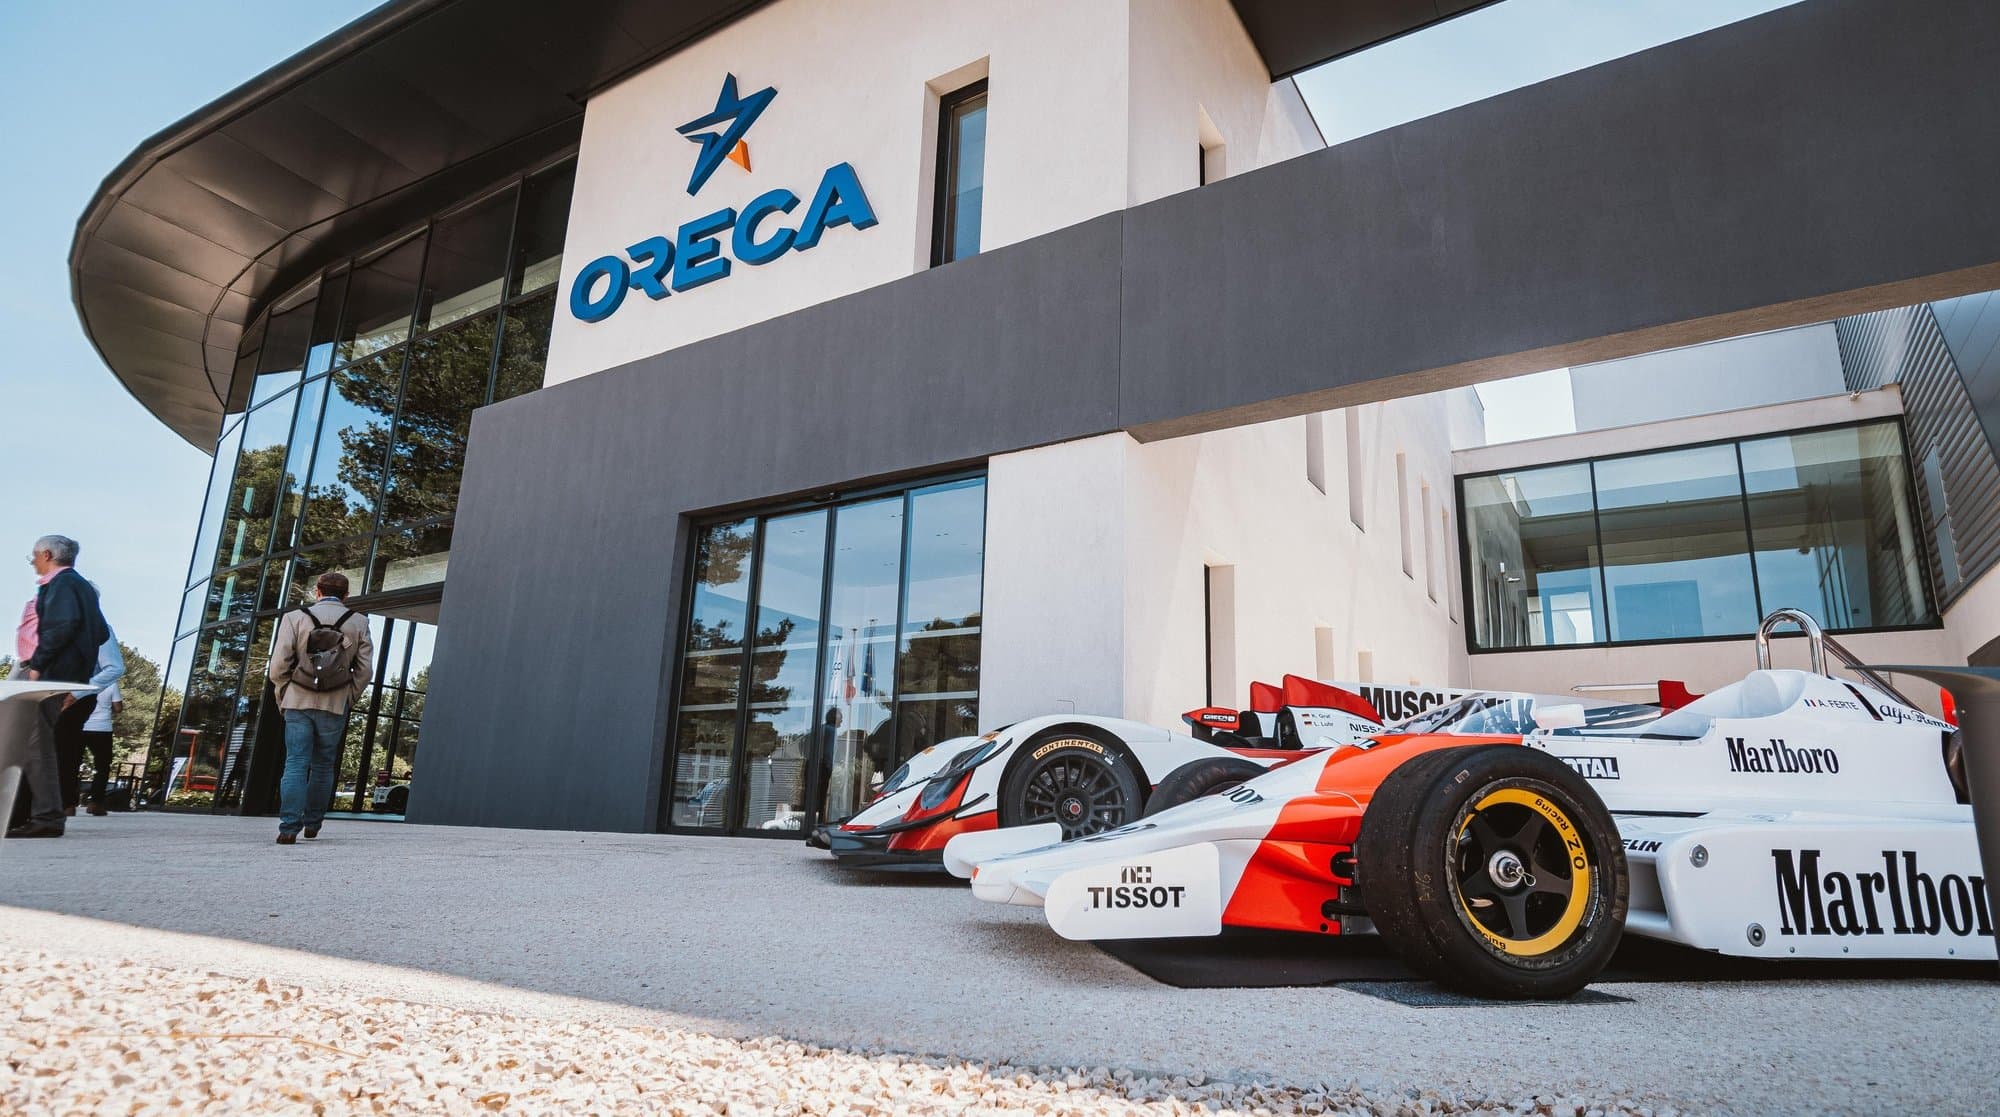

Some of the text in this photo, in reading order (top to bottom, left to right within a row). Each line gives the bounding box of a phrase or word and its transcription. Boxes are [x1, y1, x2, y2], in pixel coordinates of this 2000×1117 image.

[570, 161, 879, 324] ORECA
[1035, 739, 1102, 758] CONTINENTAL
[1725, 737, 1840, 774] Marlboro
[1535, 798, 1569, 831] Racing
[1087, 886, 1185, 909] TISSOT
